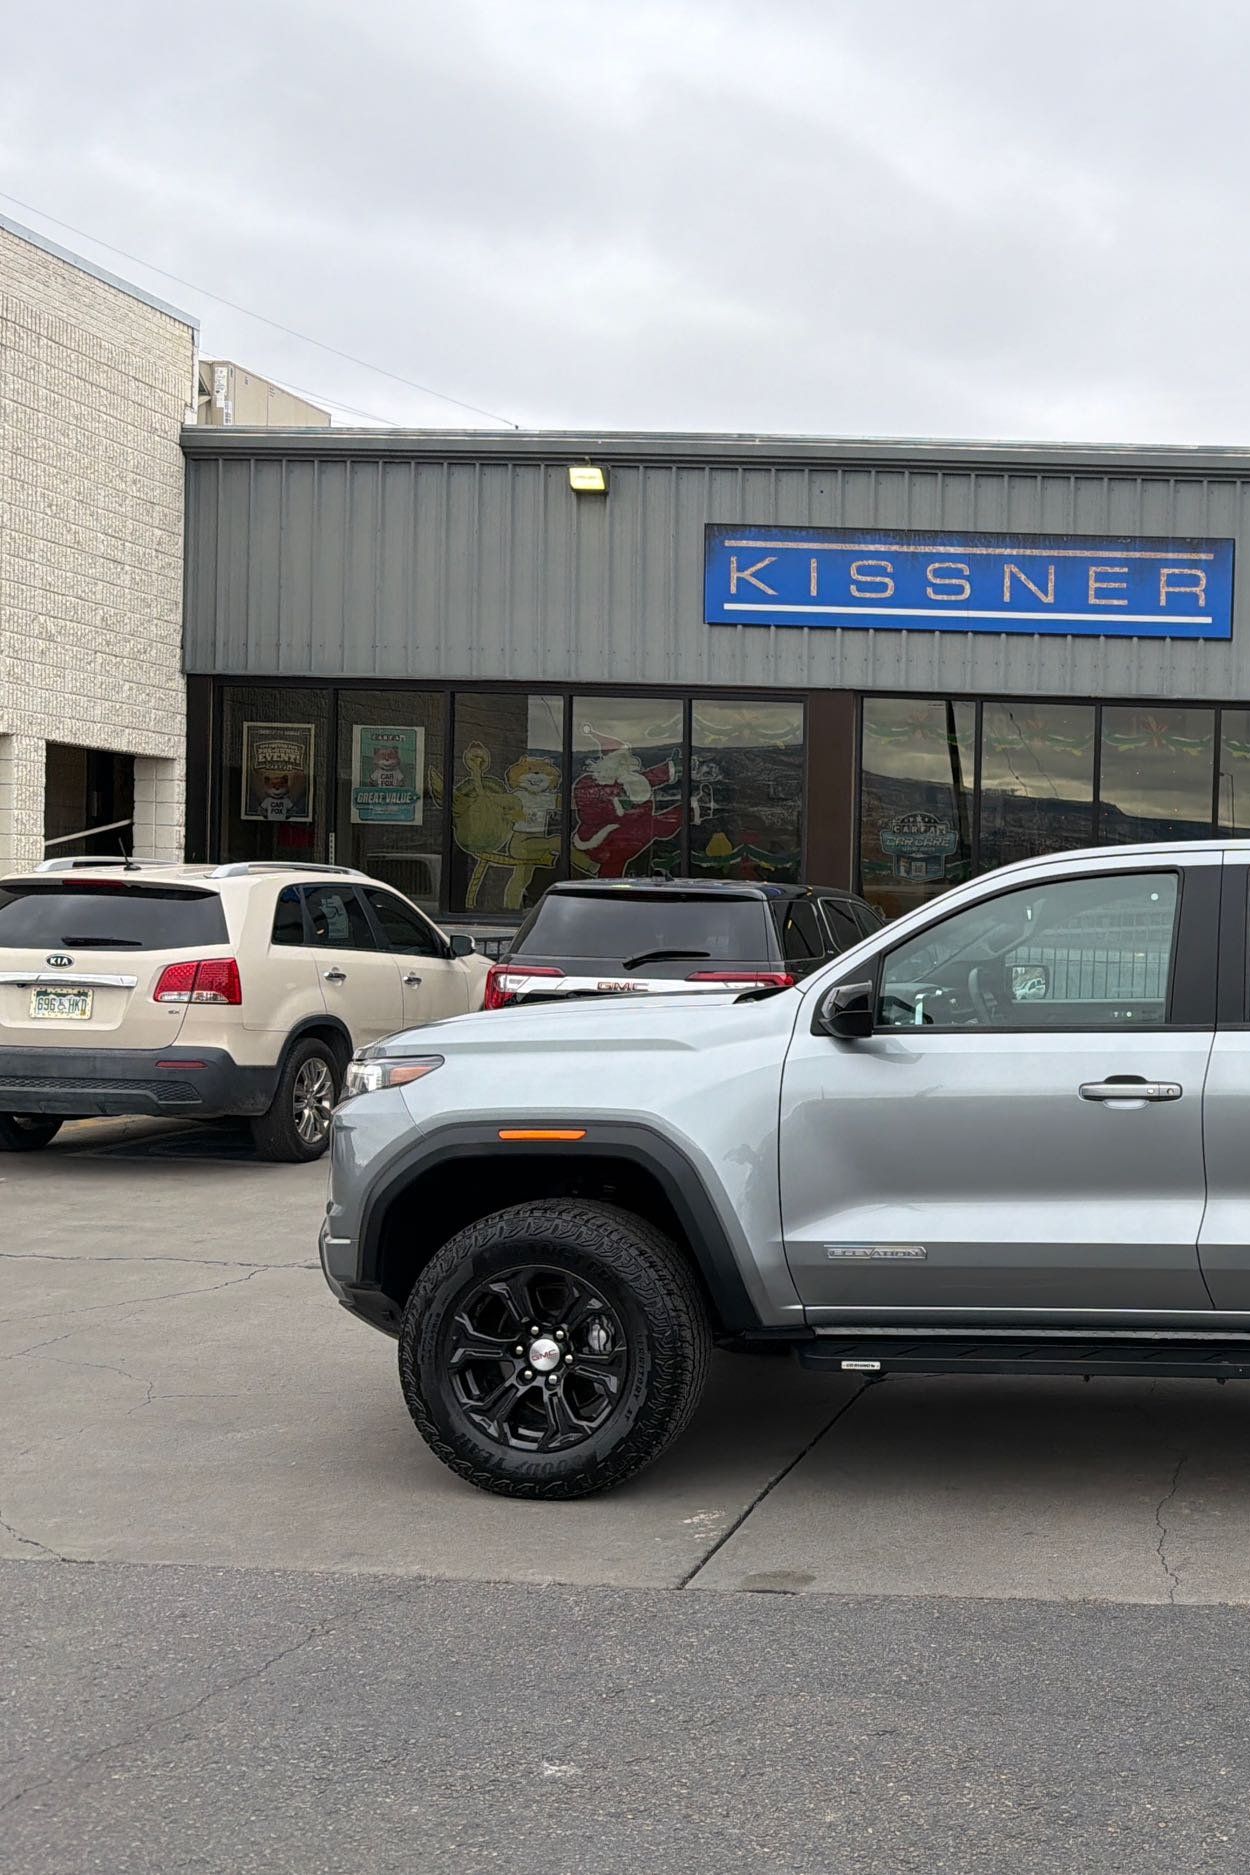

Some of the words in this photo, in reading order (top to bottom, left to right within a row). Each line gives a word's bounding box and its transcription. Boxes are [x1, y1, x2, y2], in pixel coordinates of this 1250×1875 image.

[729, 556, 1206, 606] KISSNER
[357, 792, 384, 803] GREAT
[386, 792, 412, 804] VALUE
[894, 825, 946, 836] CARFAX
[887, 837, 913, 846] CAR
[50, 957, 69, 965] KIA
[598, 982, 649, 992] GMC
[37, 998, 55, 1011] 696
[531, 1349, 556, 1361] GMC
